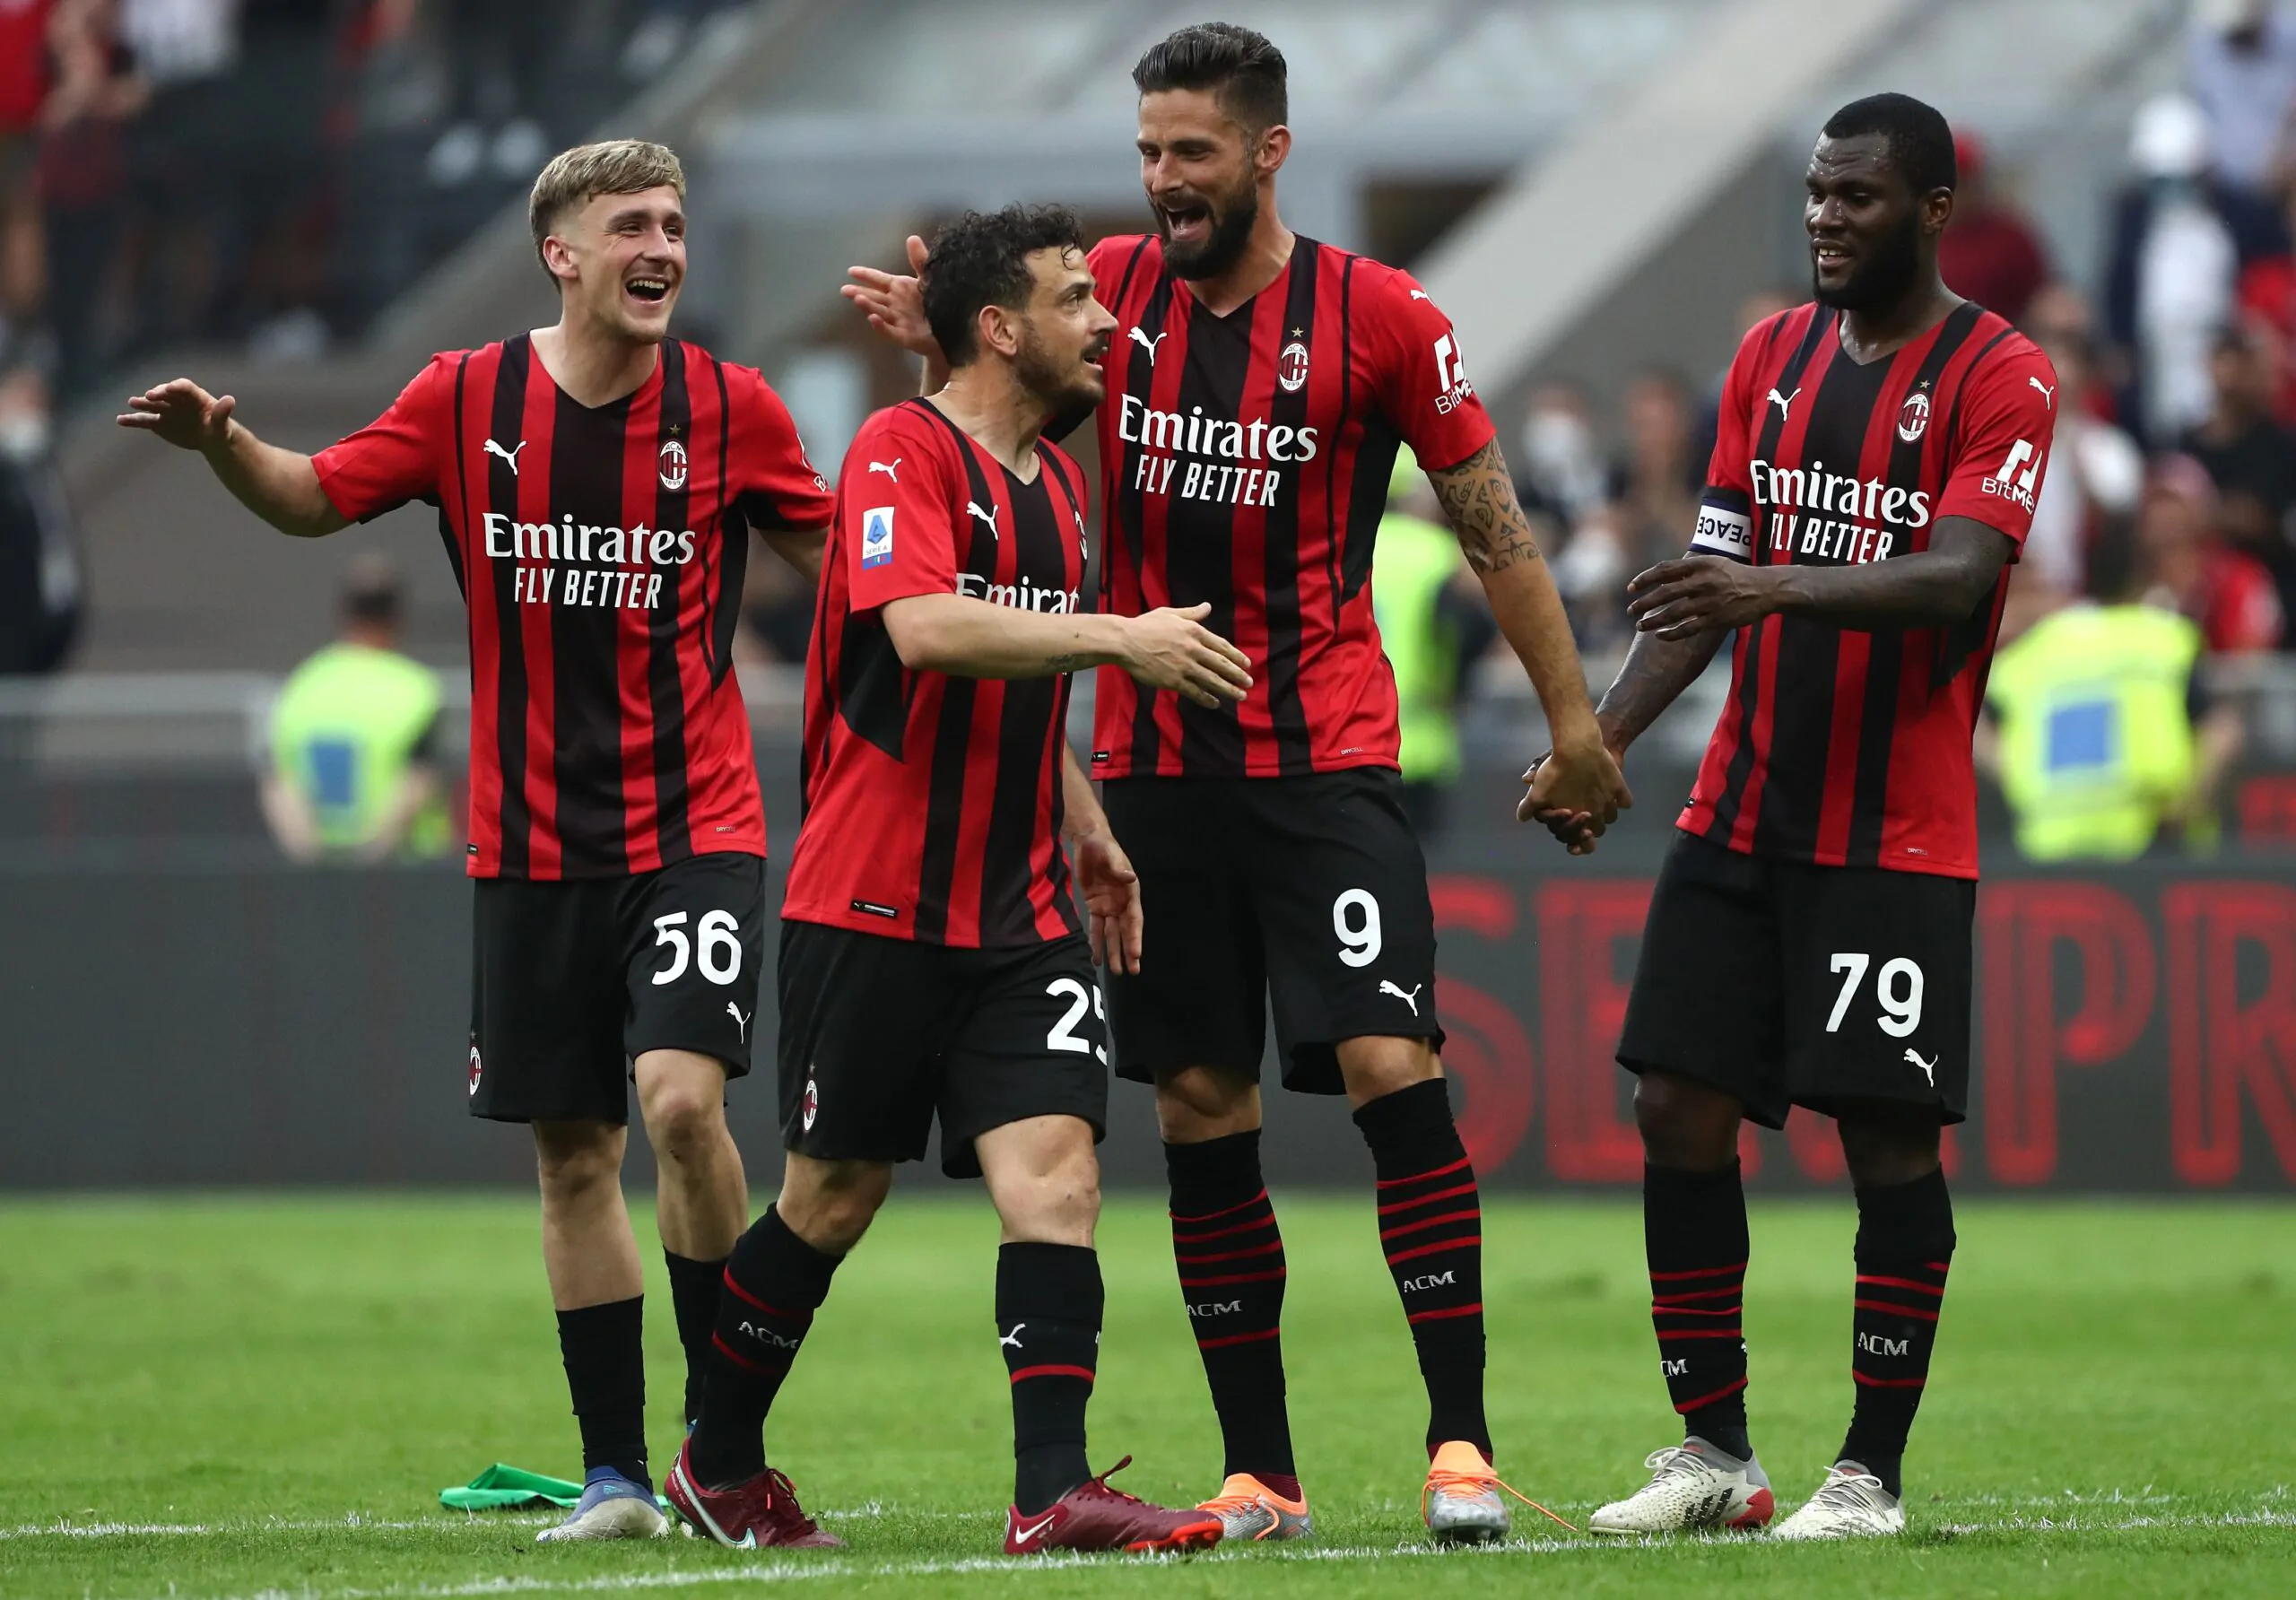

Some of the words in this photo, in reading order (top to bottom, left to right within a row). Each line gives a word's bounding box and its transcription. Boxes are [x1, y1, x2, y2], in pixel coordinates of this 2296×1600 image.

[1286, 344, 1305, 354] ACM
[1119, 393, 1318, 462] Emirates
[1135, 455, 1177, 495] FLY
[1181, 462, 1281, 507] BETTER
[1750, 460, 1929, 527] Emirates
[1981, 477, 2034, 515] BitME
[482, 512, 696, 564] Emirates
[1770, 513, 1798, 552] FLY
[1800, 517, 1893, 563] BETTER
[515, 567, 554, 604] FLY
[563, 570, 662, 609] BETTER
[651, 909, 743, 985] 56
[1334, 888, 1381, 968] 9
[1826, 952, 1924, 1038] 79
[1427, 874, 2296, 1186] SEPR
[1405, 1270, 1456, 1293] ACM
[1187, 1300, 1241, 1316] ACM
[739, 1321, 798, 1349] ACM
[1857, 1332, 1909, 1356] ACM
